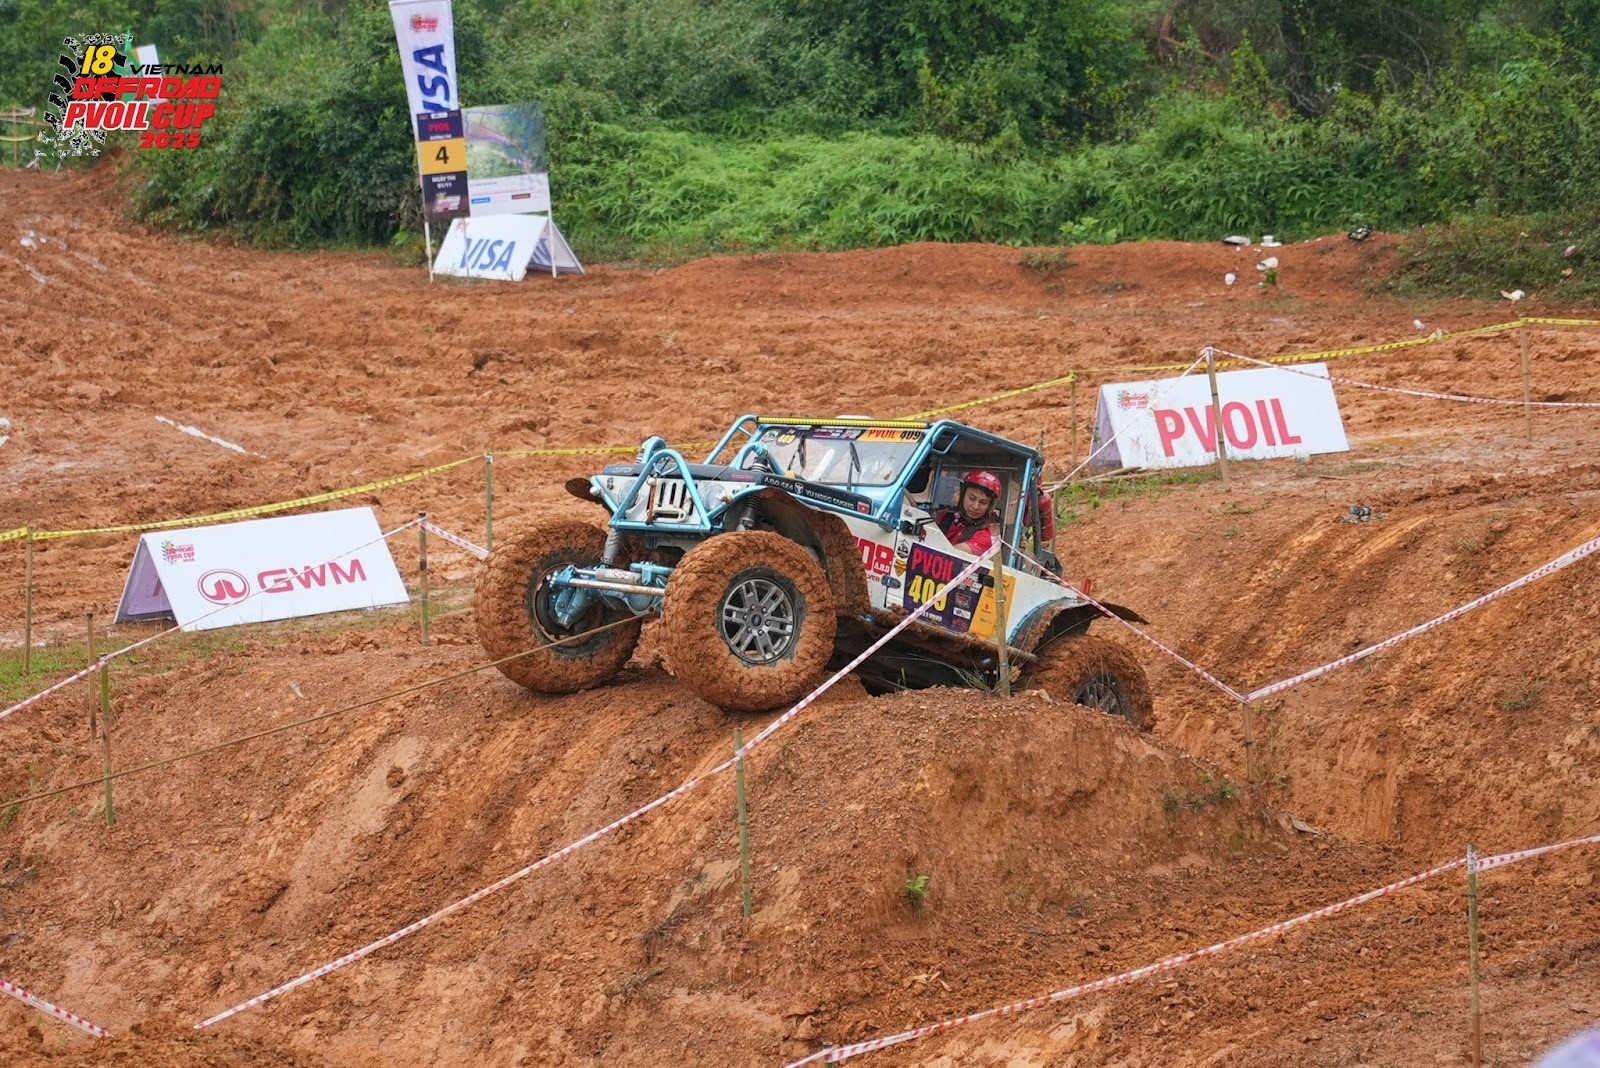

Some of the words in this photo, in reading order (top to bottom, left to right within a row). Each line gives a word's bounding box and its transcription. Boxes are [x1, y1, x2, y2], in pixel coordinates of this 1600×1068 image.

[413, 44, 450, 113] ISA
[429, 121, 451, 132] PVOIL
[435, 146, 450, 165] 4
[460, 238, 516, 271] VISA
[867, 429, 895, 439] PVOIL
[899, 430, 920, 440] 409
[1155, 398, 1302, 457] PVOIL
[851, 534, 894, 576] 08
[911, 549, 954, 583] PVOIL
[257, 559, 367, 594] GWM
[908, 574, 949, 612] 409
